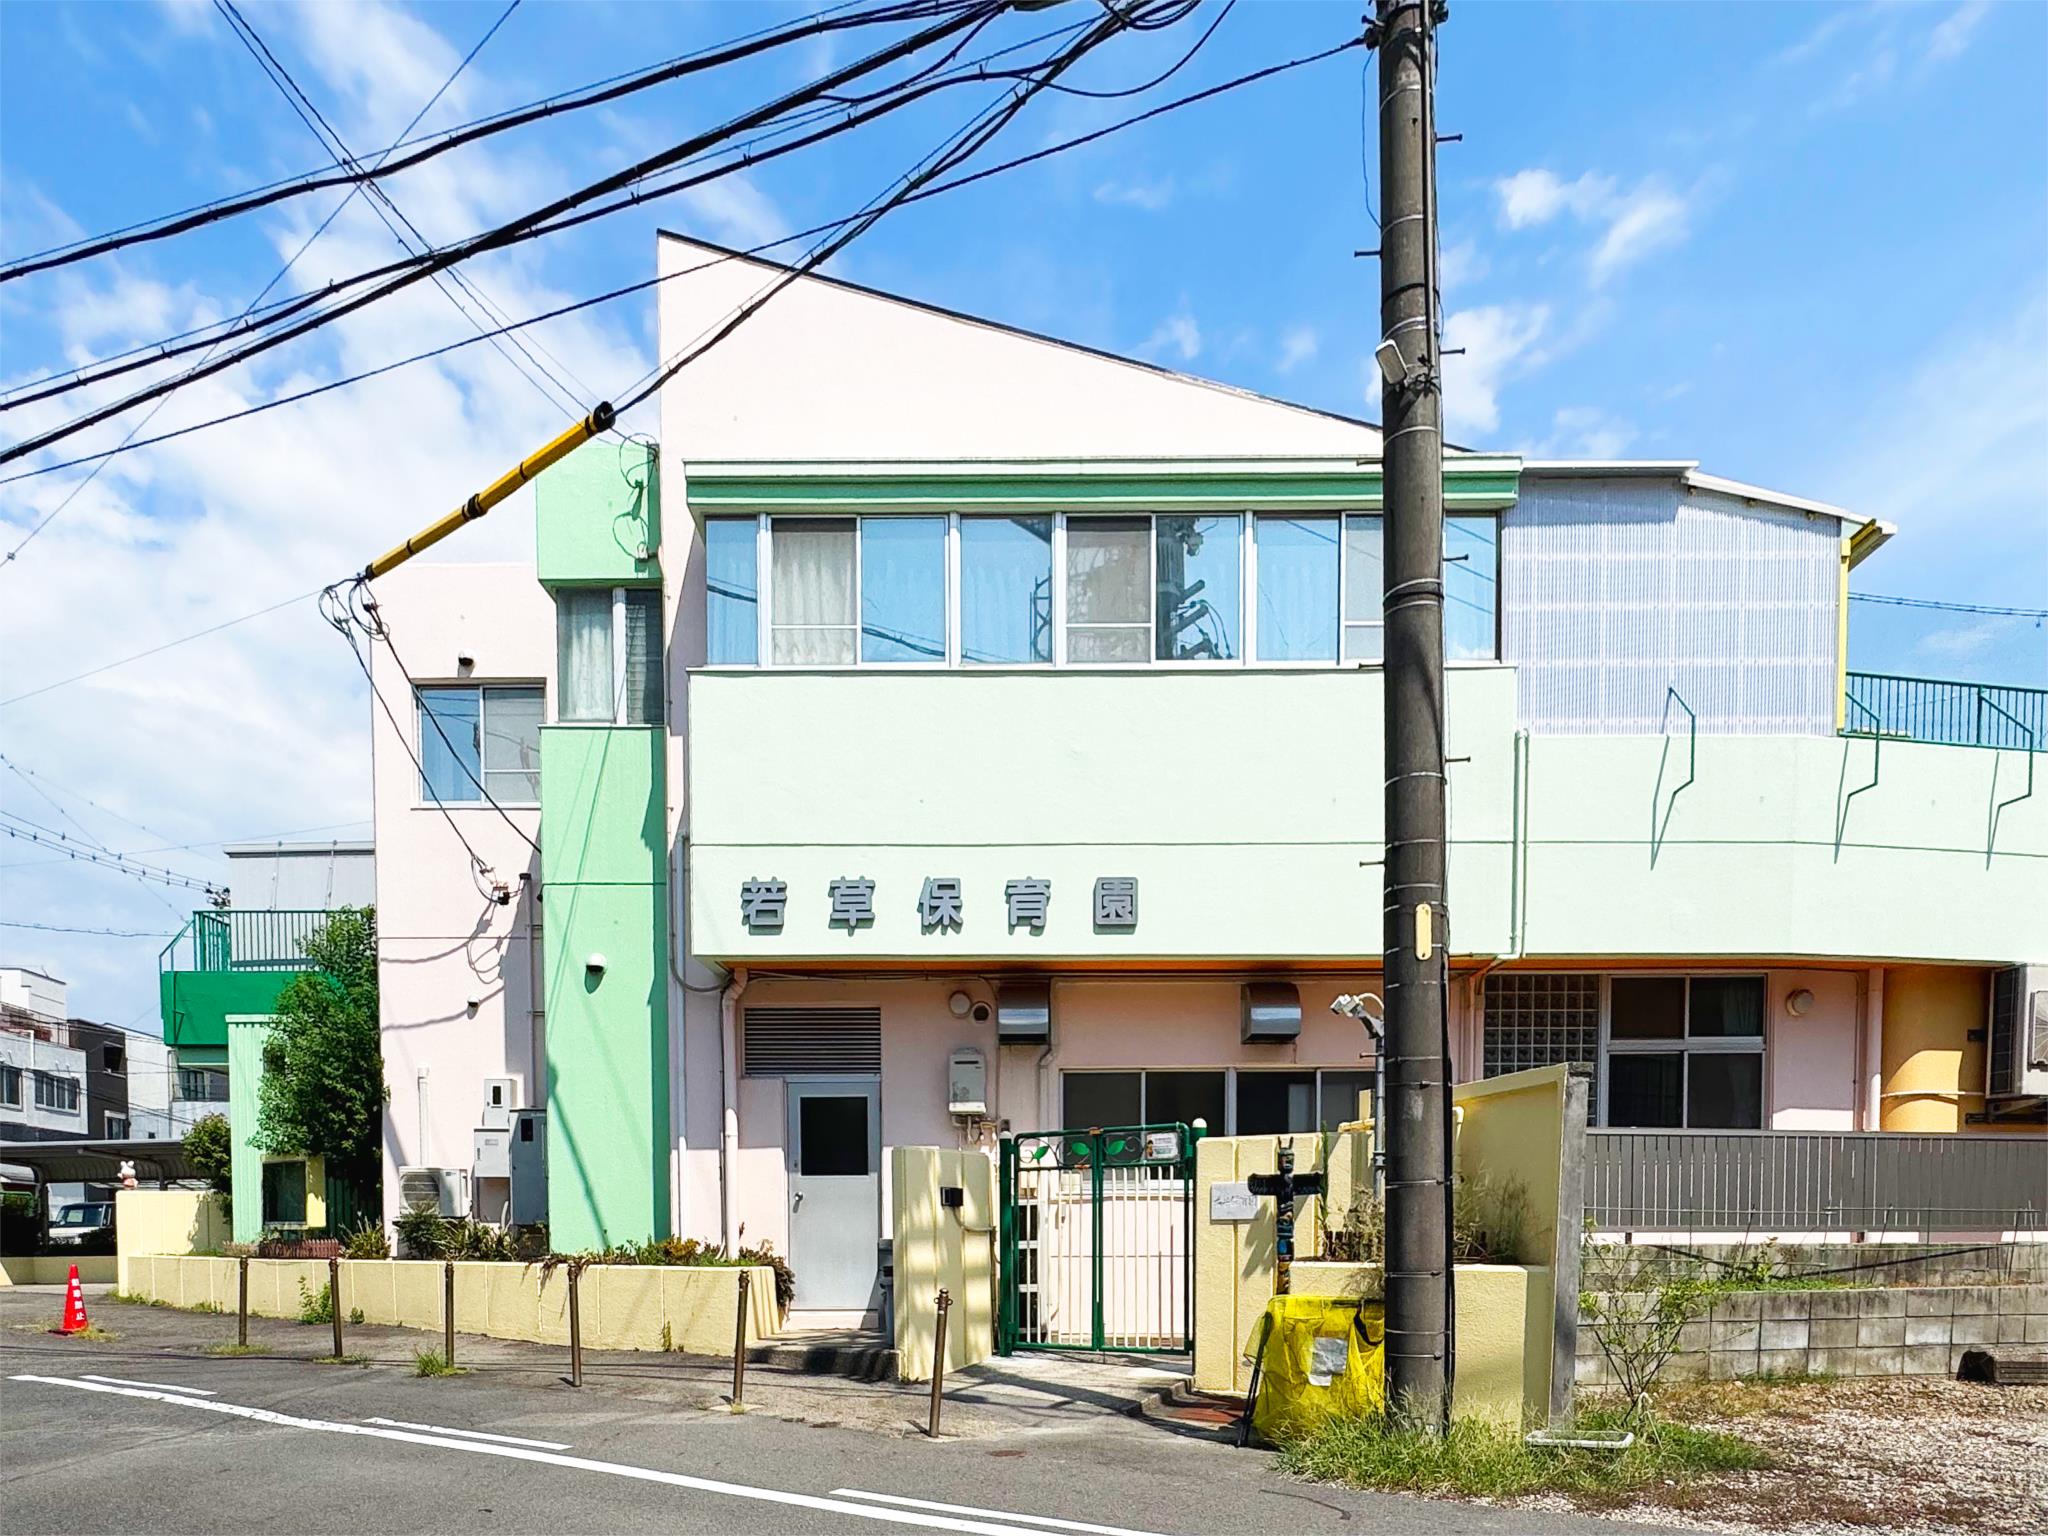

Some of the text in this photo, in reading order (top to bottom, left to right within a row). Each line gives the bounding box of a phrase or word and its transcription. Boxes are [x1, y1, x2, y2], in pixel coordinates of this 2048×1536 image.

[740, 875, 1138, 930] 若草保育園
